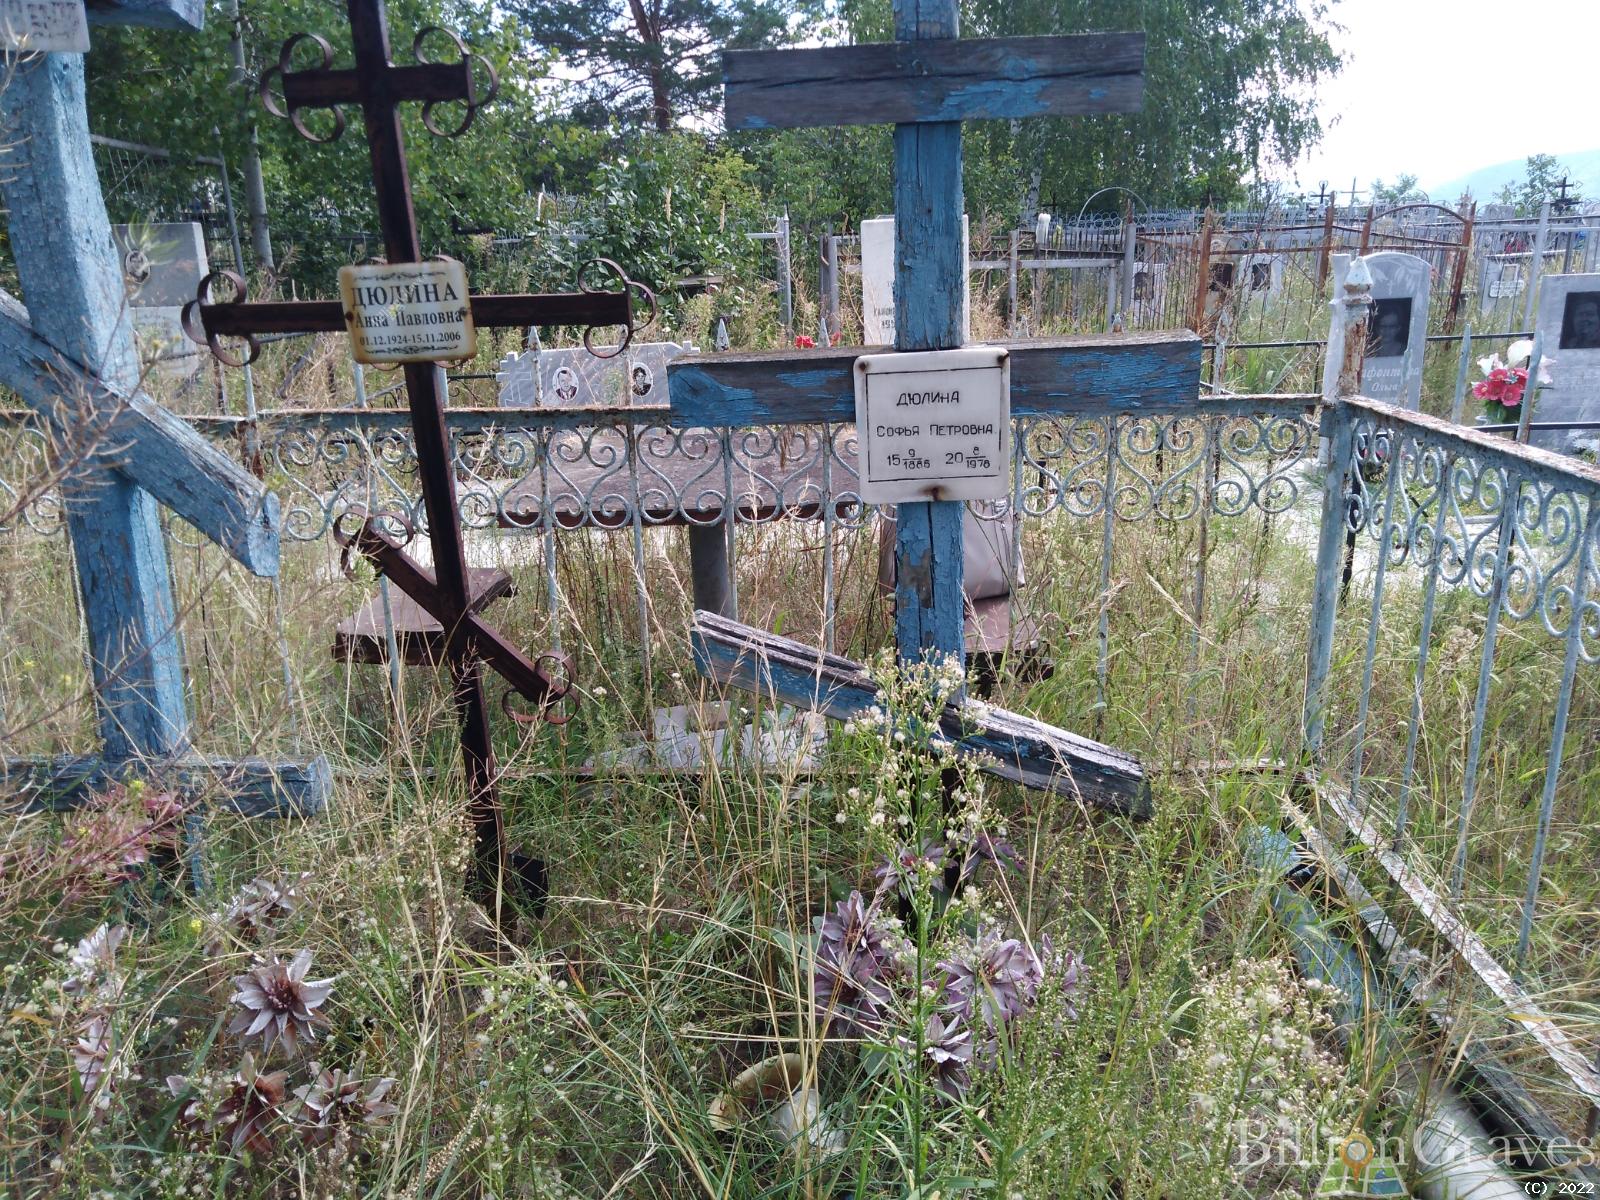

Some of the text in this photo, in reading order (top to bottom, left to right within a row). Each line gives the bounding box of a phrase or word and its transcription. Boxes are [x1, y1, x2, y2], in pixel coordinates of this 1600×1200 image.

[352, 282, 459, 309] ДЮЛИНА
[354, 309, 463, 328] Анна Павловна
[896, 390, 960, 407] ДЮЛИНА
